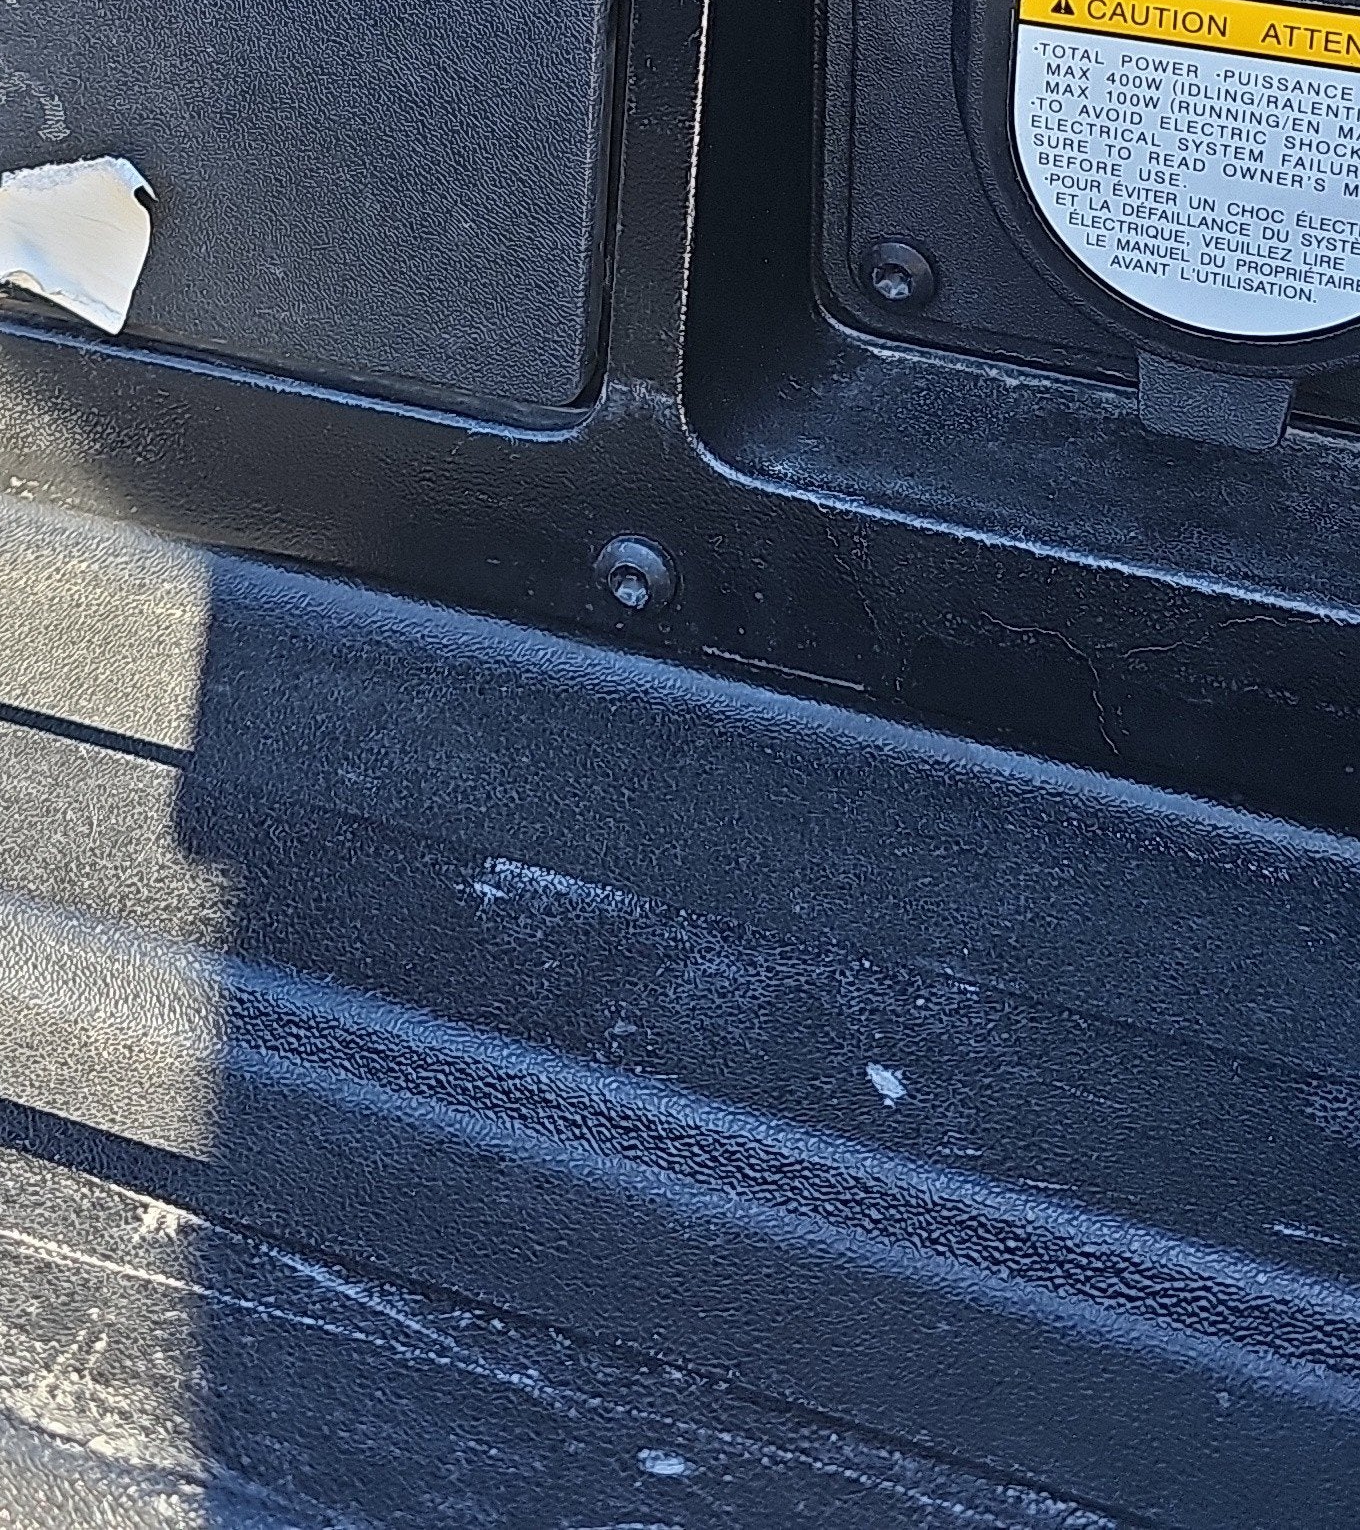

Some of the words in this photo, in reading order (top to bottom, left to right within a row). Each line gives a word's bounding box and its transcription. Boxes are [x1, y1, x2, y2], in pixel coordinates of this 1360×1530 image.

[1046, 61, 1091, 82] MAX
[1105, 72, 1163, 92] 400W
[1121, 54, 1199, 79] POWER
[1045, 80, 1090, 100] MAX
[1106, 89, 1161, 110] 100W
[1170, 97, 1321, 135] (RUNNING/EN
[1077, 104, 1143, 126] AVOID
[1159, 115, 1267, 145] ELECTRIC
[1031, 114, 1162, 148] ELECTRICAL
[1177, 137, 1264, 164] SYSTEM
[1032, 132, 1090, 155] SURE
[1104, 143, 1132, 161] TO
[1148, 150, 1206, 173] READ
[1222, 163, 1326, 193] OWNER'S
[1038, 151, 1123, 178] BEFORE
[1138, 167, 1187, 189] USE.
[1055, 191, 1080, 208] ET
[1088, 196, 1112, 214] LA
[1122, 201, 1252, 238] DÉFAILLANCE
[1262, 225, 1290, 244] DU
[1112, 179, 1178, 207] ÉVITER
[1188, 195, 1216, 213] UN
[1227, 202, 1285, 224] CHOC
[1068, 208, 1190, 248] ÉLECTRIQUE,
[1201, 233, 1293, 263] VEUILLEZ
[1302, 251, 1346, 272] LIRE
[1085, 231, 1107, 249] LE
[1116, 237, 1191, 263] MANUEL
[1200, 251, 1226, 269] DU
[1109, 254, 1171, 277] AVANT
[1180, 266, 1317, 304] L'UTILISATION.
